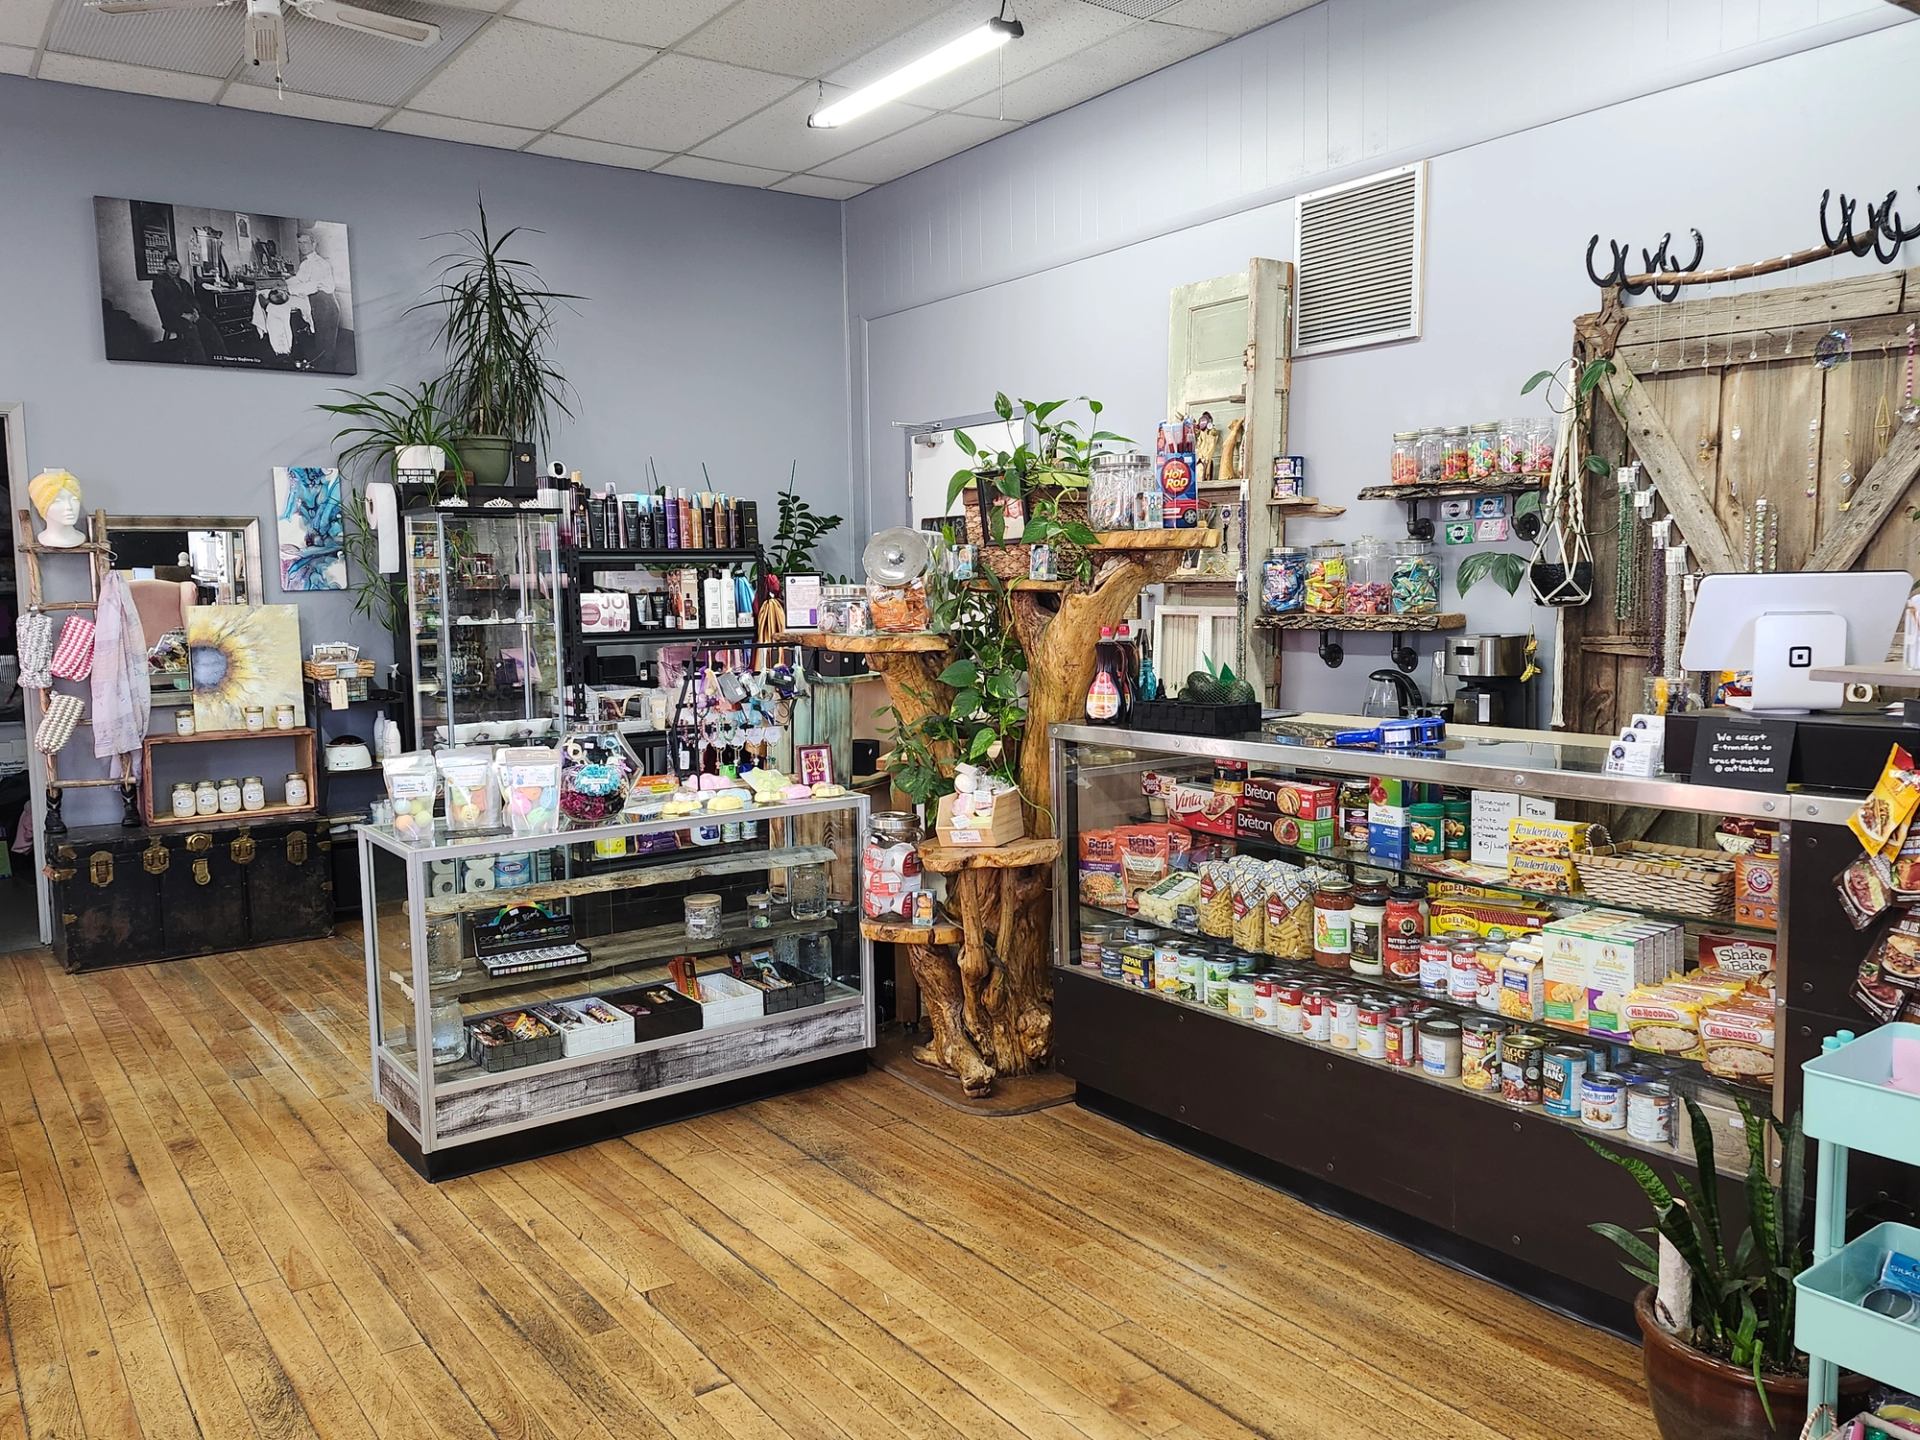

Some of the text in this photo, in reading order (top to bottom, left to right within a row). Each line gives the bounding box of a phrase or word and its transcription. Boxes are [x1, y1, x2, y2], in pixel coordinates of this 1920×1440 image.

[1164, 469, 1185, 479] HOT
[1166, 478, 1188, 488] ROD
[1716, 732, 1732, 741] We
[1244, 782, 1276, 801] Breton
[1237, 812, 1273, 832] Breton
[1515, 823, 1568, 840] Tenderflake
[1088, 838, 1114, 849] Ben's
[1088, 848, 1114, 857] Original
[1513, 855, 1565, 873] Tenderflake
[1440, 884, 1453, 892] OLD
[1454, 884, 1463, 892] EL
[1162, 953, 1178, 962] Dole
[1719, 949, 1768, 962] Shake
[1123, 955, 1142, 968] SPAM
[1730, 962, 1768, 972] Bake
[1720, 1028, 1757, 1042] NOODLES
[1594, 1092, 1616, 1101] Brand
